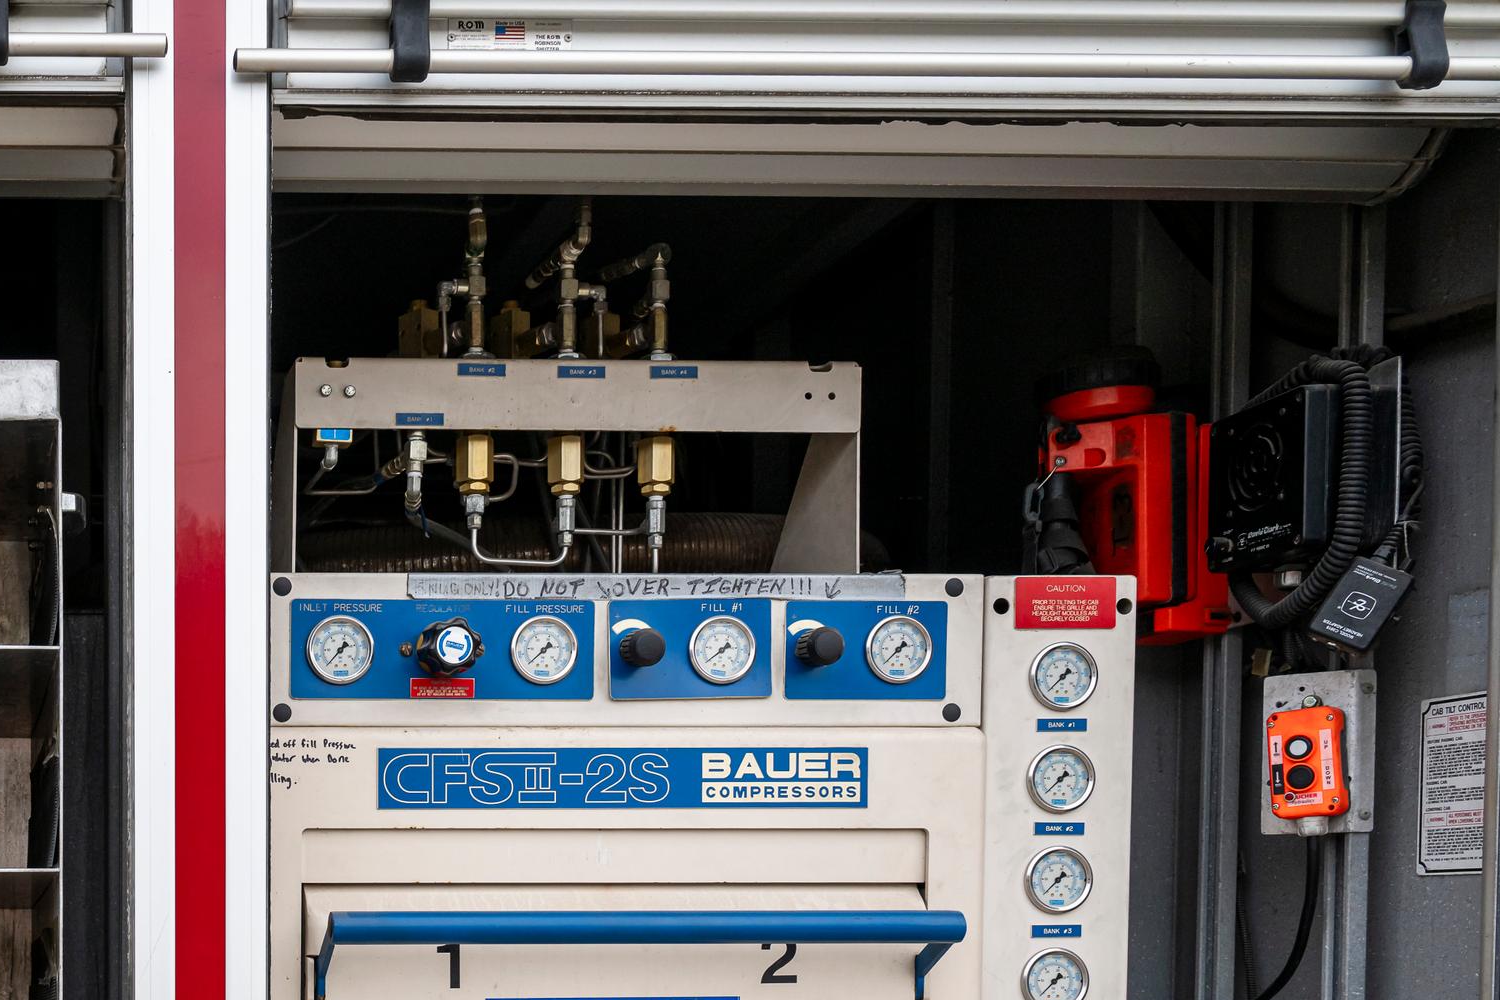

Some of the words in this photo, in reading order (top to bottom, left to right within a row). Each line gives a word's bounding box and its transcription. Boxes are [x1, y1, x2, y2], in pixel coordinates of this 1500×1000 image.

[503, 580, 530, 597] DO
[540, 578, 586, 597] NOT
[1046, 585, 1086, 593] CAUTION
[299, 604, 327, 613] INLET
[333, 603, 383, 613] PRESSURE
[505, 605, 530, 614] FILL
[536, 604, 585, 614] PRESSURE
[701, 603, 725, 613] FILL
[731, 603, 743, 613] #1
[877, 605, 901, 614] FILL
[907, 605, 920, 615] #2
[1431, 707, 1443, 716] CAB
[1445, 706, 1456, 714] TILT
[1458, 702, 1486, 712] CONTROL
[283, 739, 296, 748] off
[701, 752, 861, 779] BAUER
[706, 785, 857, 799] COMPRESSORS
[436, 944, 460, 989] 1
[760, 944, 798, 984] 2
